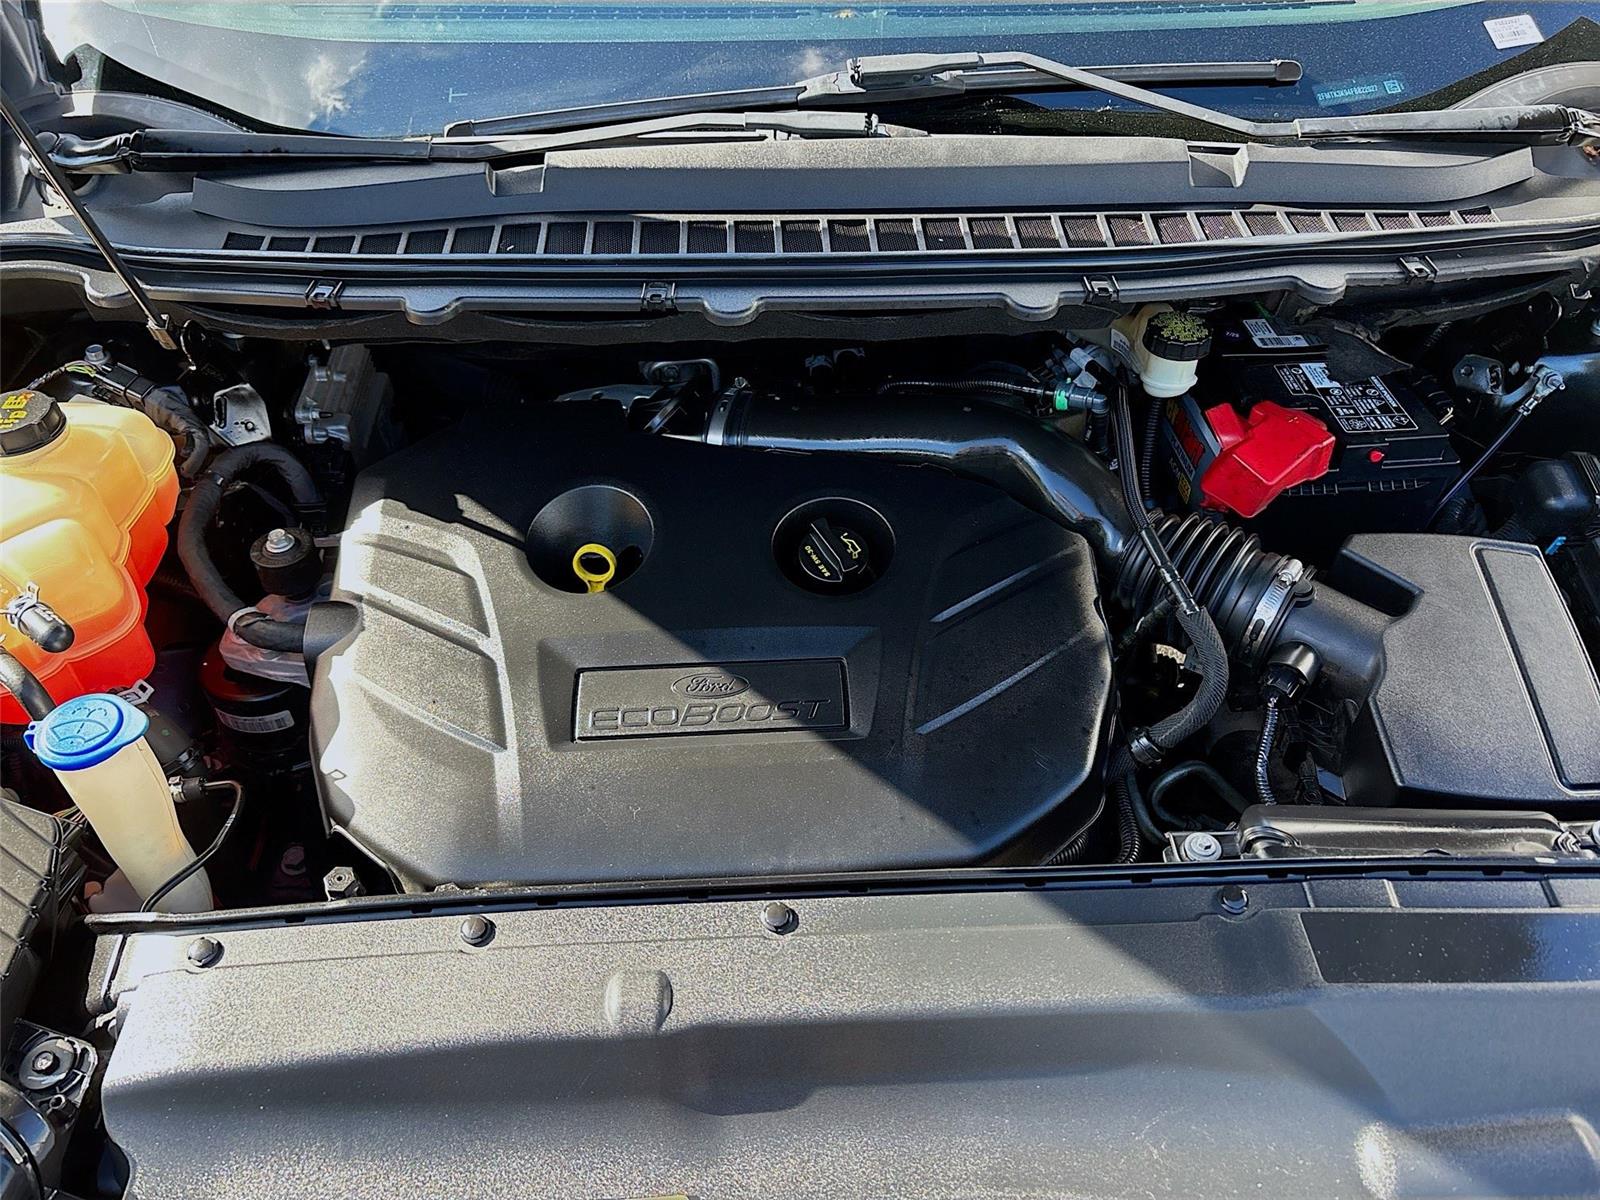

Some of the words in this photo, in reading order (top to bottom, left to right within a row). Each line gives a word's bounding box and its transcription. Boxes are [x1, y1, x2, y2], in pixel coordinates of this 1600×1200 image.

[804, 545, 821, 565] 5W-30
[817, 563, 831, 577] SAE
[685, 674, 737, 694] Ford
